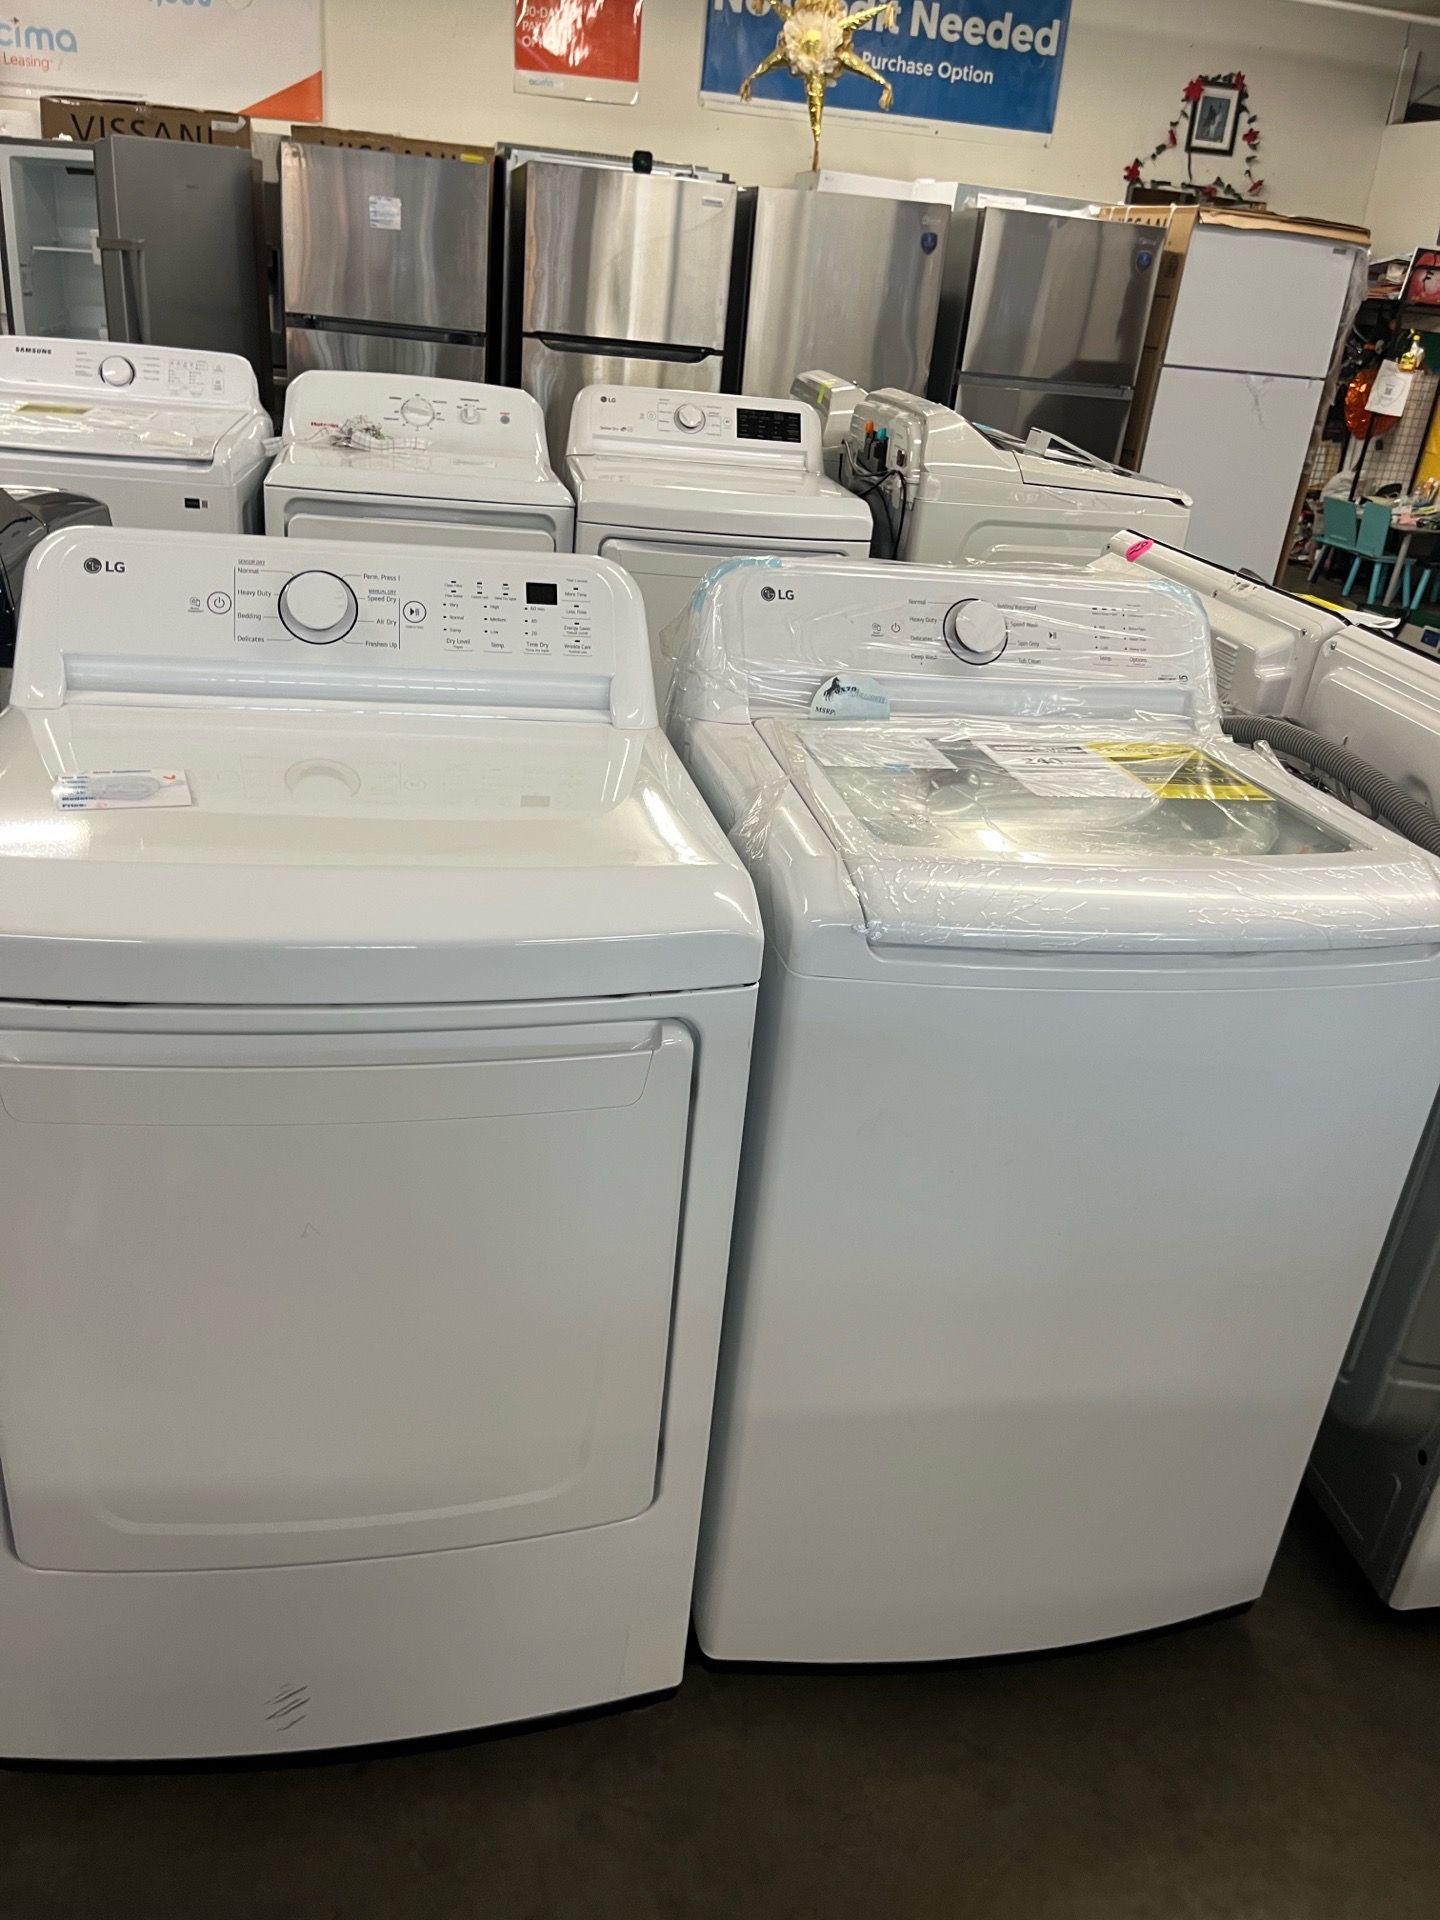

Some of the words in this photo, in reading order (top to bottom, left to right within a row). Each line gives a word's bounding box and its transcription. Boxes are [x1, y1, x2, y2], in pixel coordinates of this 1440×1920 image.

[910, 2, 1061, 56] Needed
[862, 51, 933, 77] Purchase
[938, 62, 994, 85] Option
[15, 346, 52, 355] SAMSUNG
[105, 561, 126, 573] LG
[238, 589, 256, 597] Heavy
[257, 589, 271, 598] Duty
[778, 589, 795, 601] LG
[387, 596, 397, 604] Dry
[389, 641, 398, 649] Up
